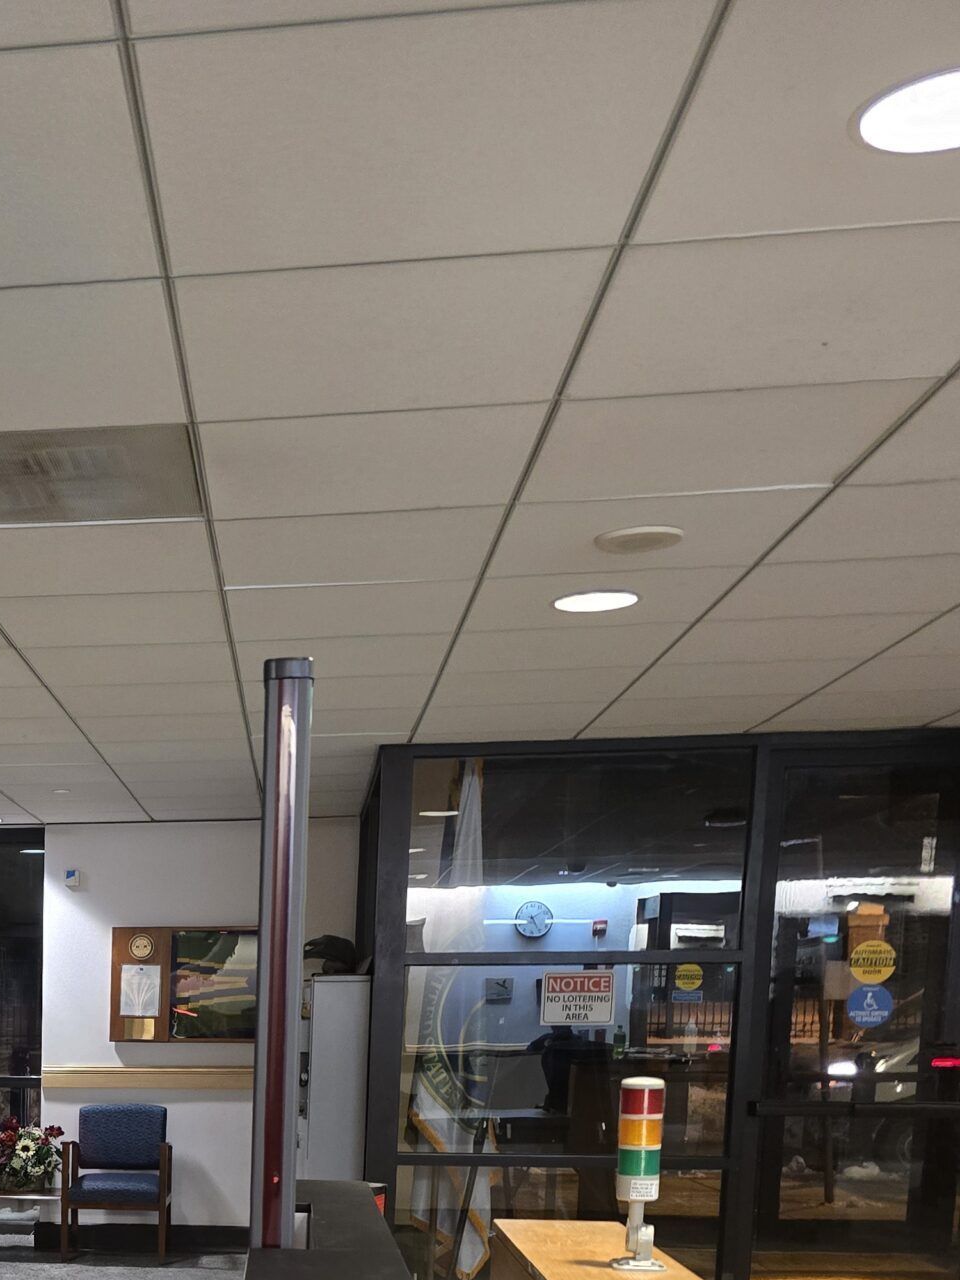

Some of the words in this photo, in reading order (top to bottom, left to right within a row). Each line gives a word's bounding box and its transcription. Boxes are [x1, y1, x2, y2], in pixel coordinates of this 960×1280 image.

[851, 957, 894, 967] CAUTION
[548, 977, 610, 992] NOTICE
[547, 995, 560, 1003] NO
[563, 994, 610, 1003] LOITERING
[562, 1004, 571, 1012] IN
[574, 1004, 593, 1012] THIS
[565, 1013, 589, 1021] AREA
